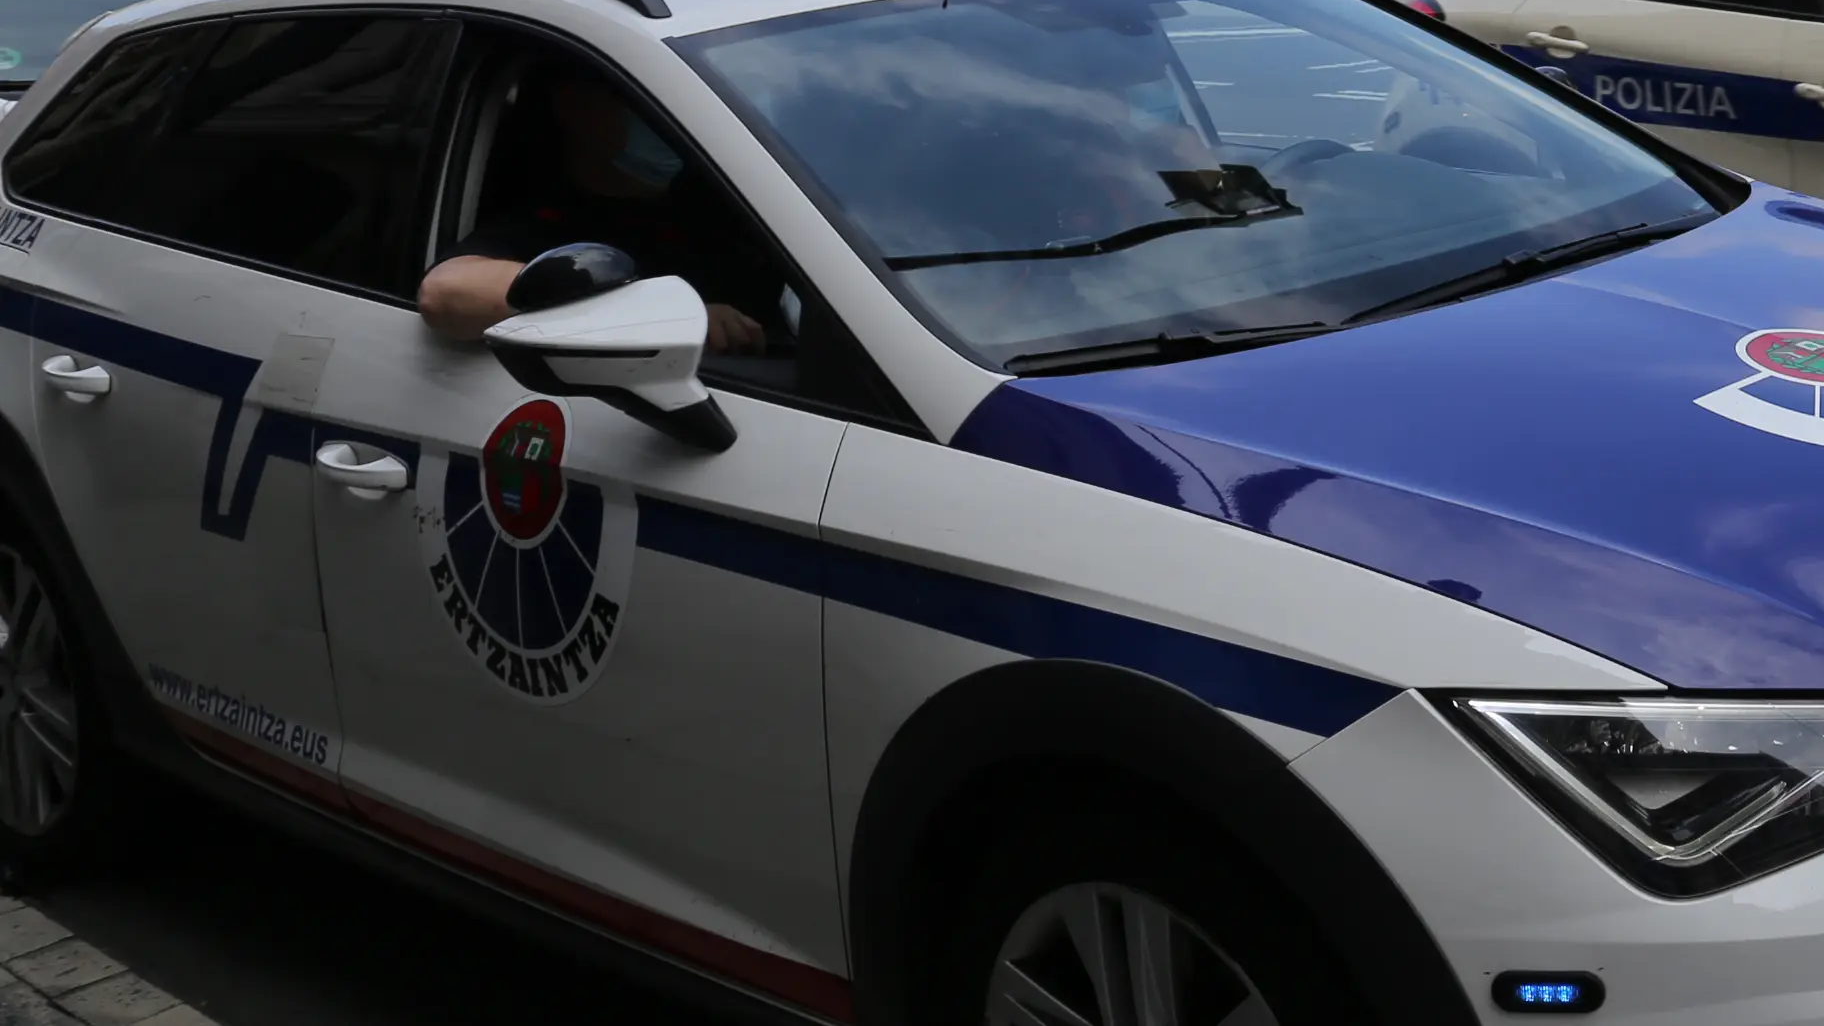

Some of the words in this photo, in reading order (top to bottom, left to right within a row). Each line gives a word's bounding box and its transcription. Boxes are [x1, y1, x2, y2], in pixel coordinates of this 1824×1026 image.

[1594, 74, 1738, 120] POLIZIA
[429, 553, 620, 698] ERTZAINTZA
[148, 662, 329, 766] www.ertzaintza.eus
